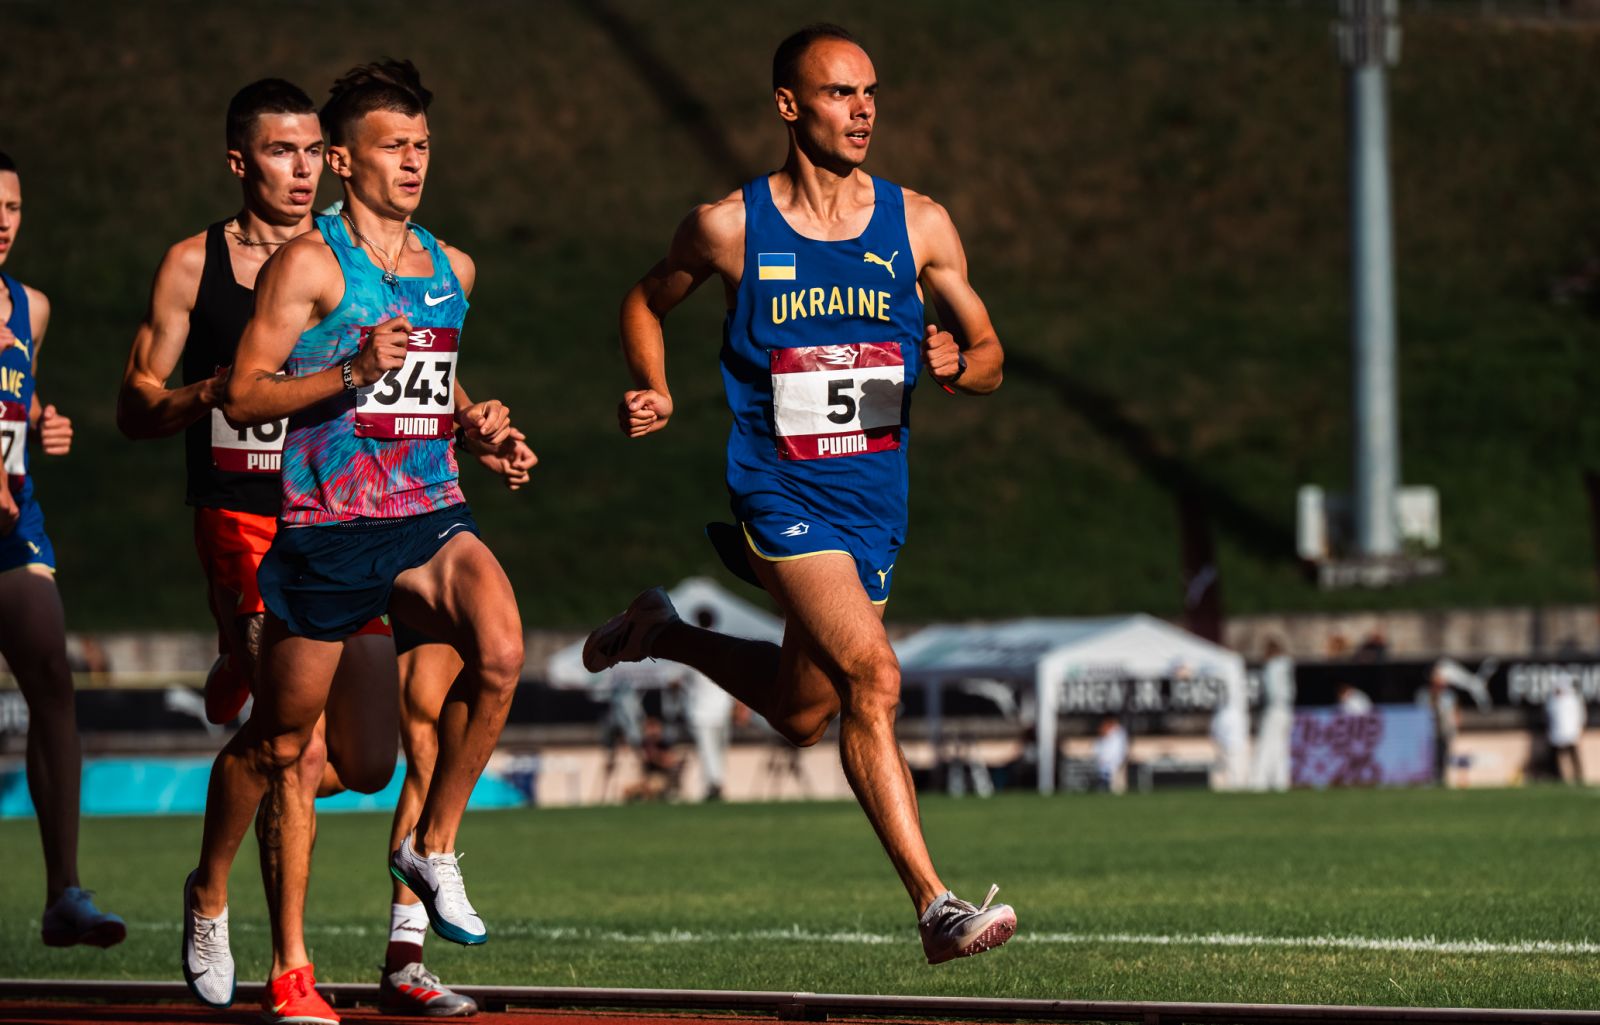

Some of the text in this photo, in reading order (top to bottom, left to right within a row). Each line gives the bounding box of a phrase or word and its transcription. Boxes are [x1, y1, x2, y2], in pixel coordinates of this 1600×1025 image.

[772, 286, 892, 324] UKRAINE
[0, 366, 25, 399] INE
[373, 360, 451, 406] 343
[826, 378, 857, 425] 5
[394, 417, 439, 436] PUMA
[817, 433, 868, 456] PUMA
[247, 453, 282, 470] PUM
